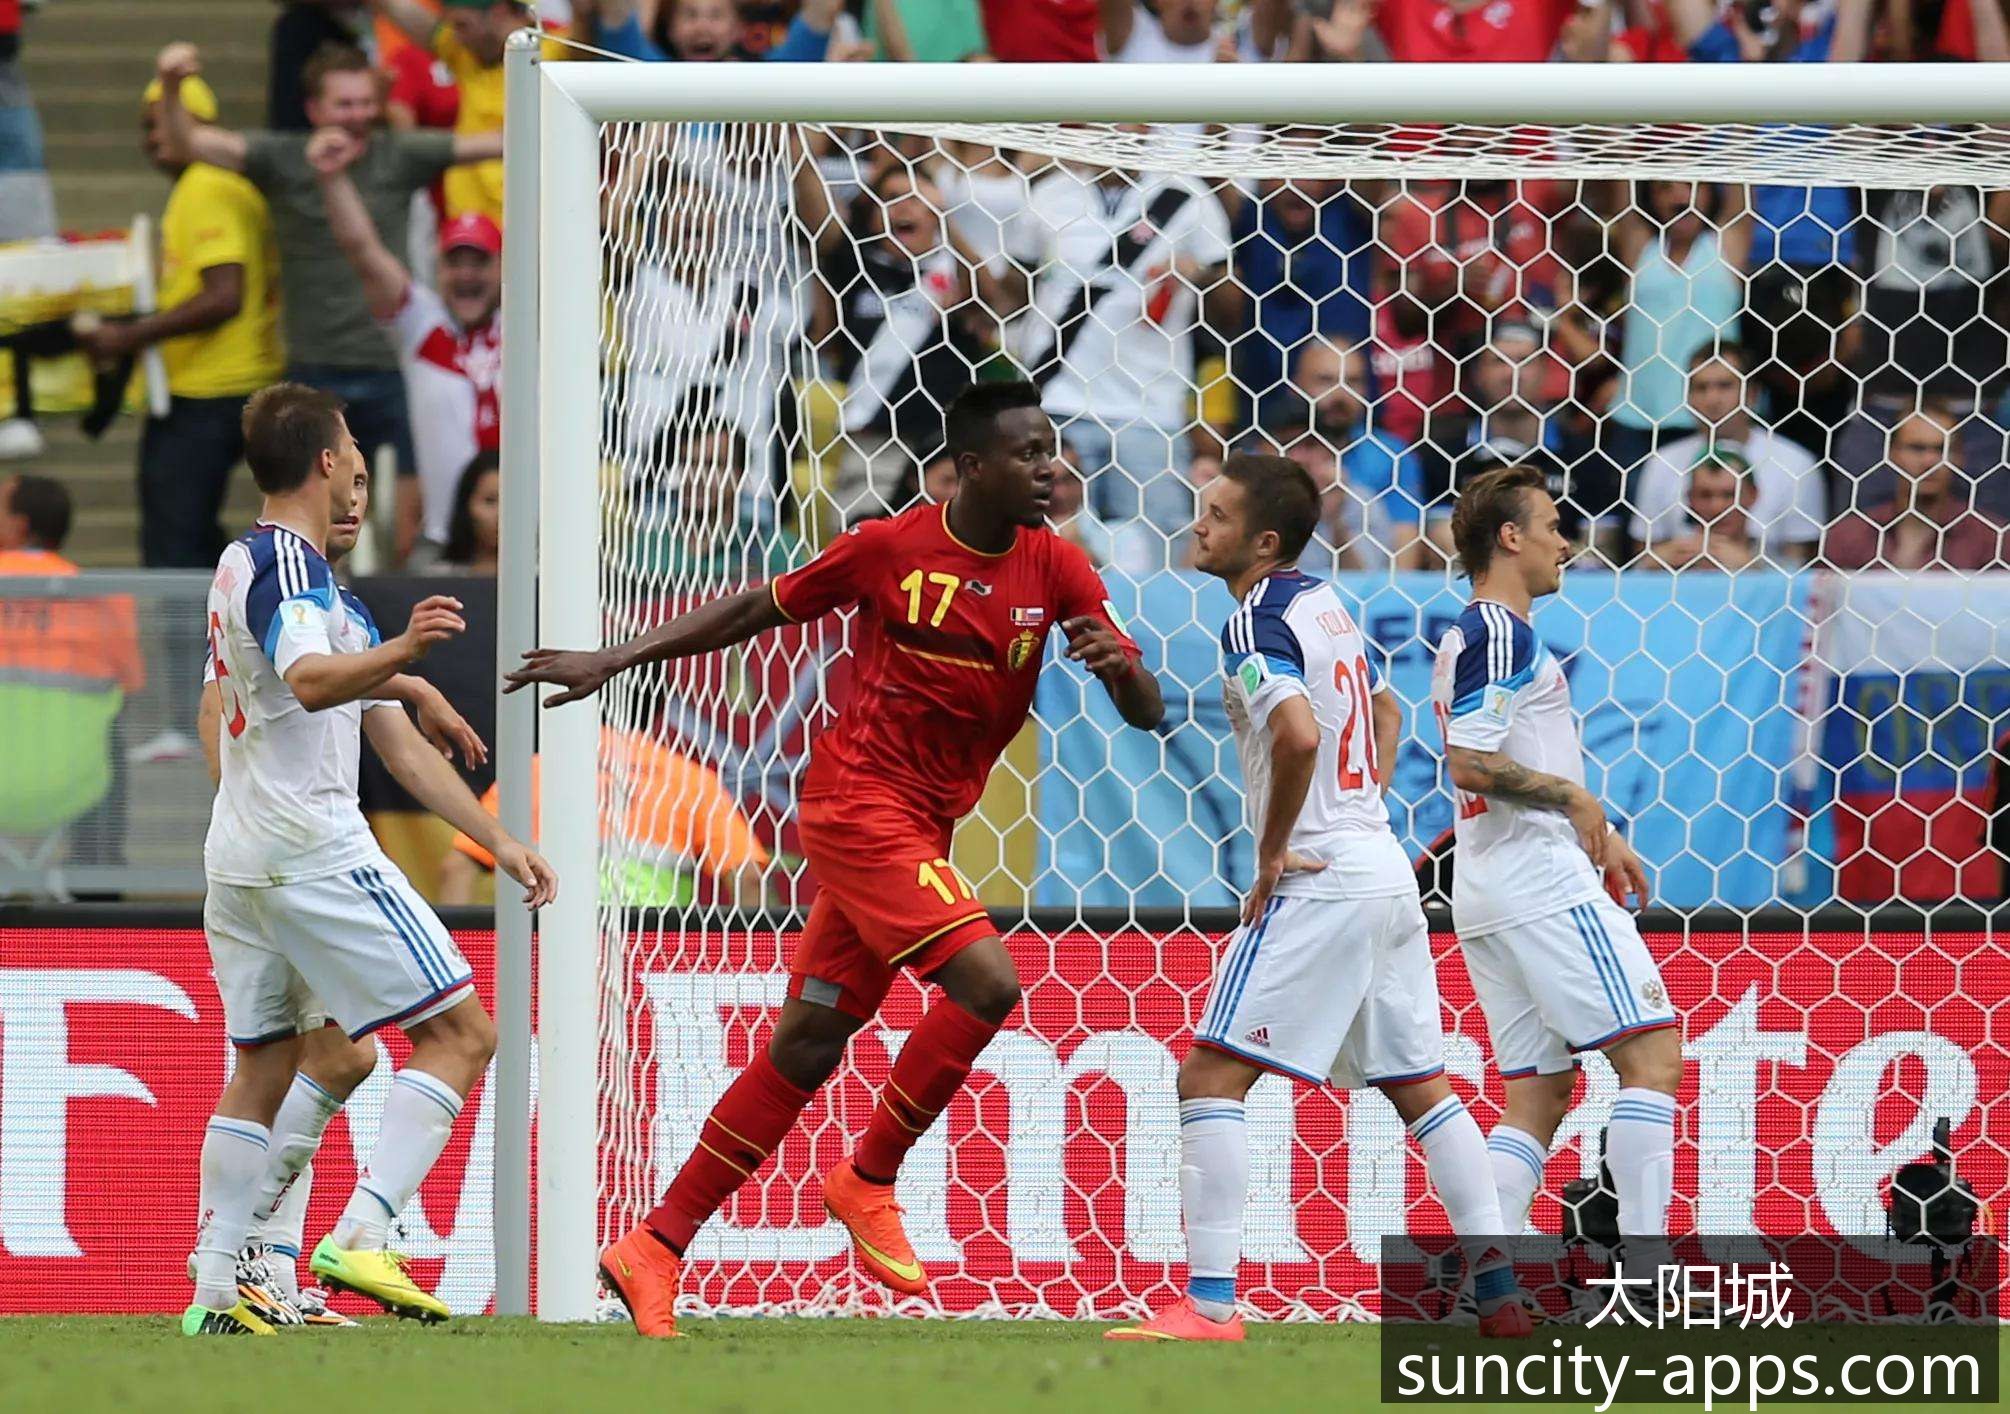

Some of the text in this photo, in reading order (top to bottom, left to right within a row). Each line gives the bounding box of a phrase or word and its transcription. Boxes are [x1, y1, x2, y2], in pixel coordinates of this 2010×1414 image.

[900, 568, 961, 628] 17
[1333, 654, 1381, 793] 20
[917, 857, 973, 906] 17
[0, 966, 540, 1315] Fy
